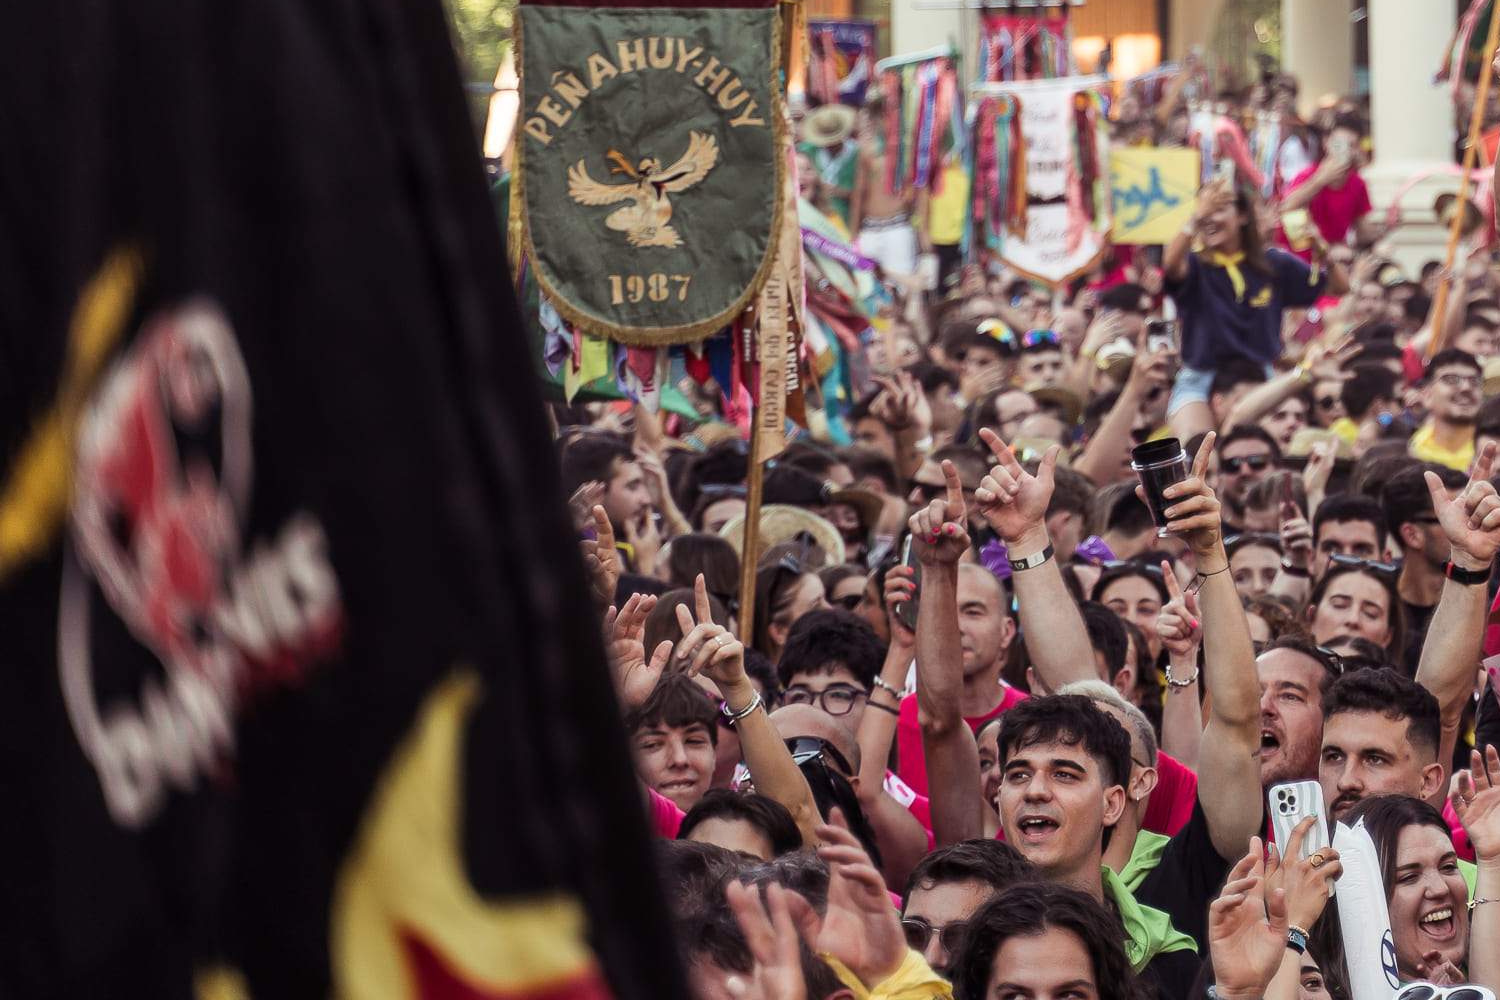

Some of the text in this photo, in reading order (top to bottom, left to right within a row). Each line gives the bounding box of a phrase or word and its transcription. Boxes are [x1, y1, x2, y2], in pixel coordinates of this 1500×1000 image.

[523, 36, 766, 146] PEÑA HUY-HUY
[608, 273, 691, 305] 1987
